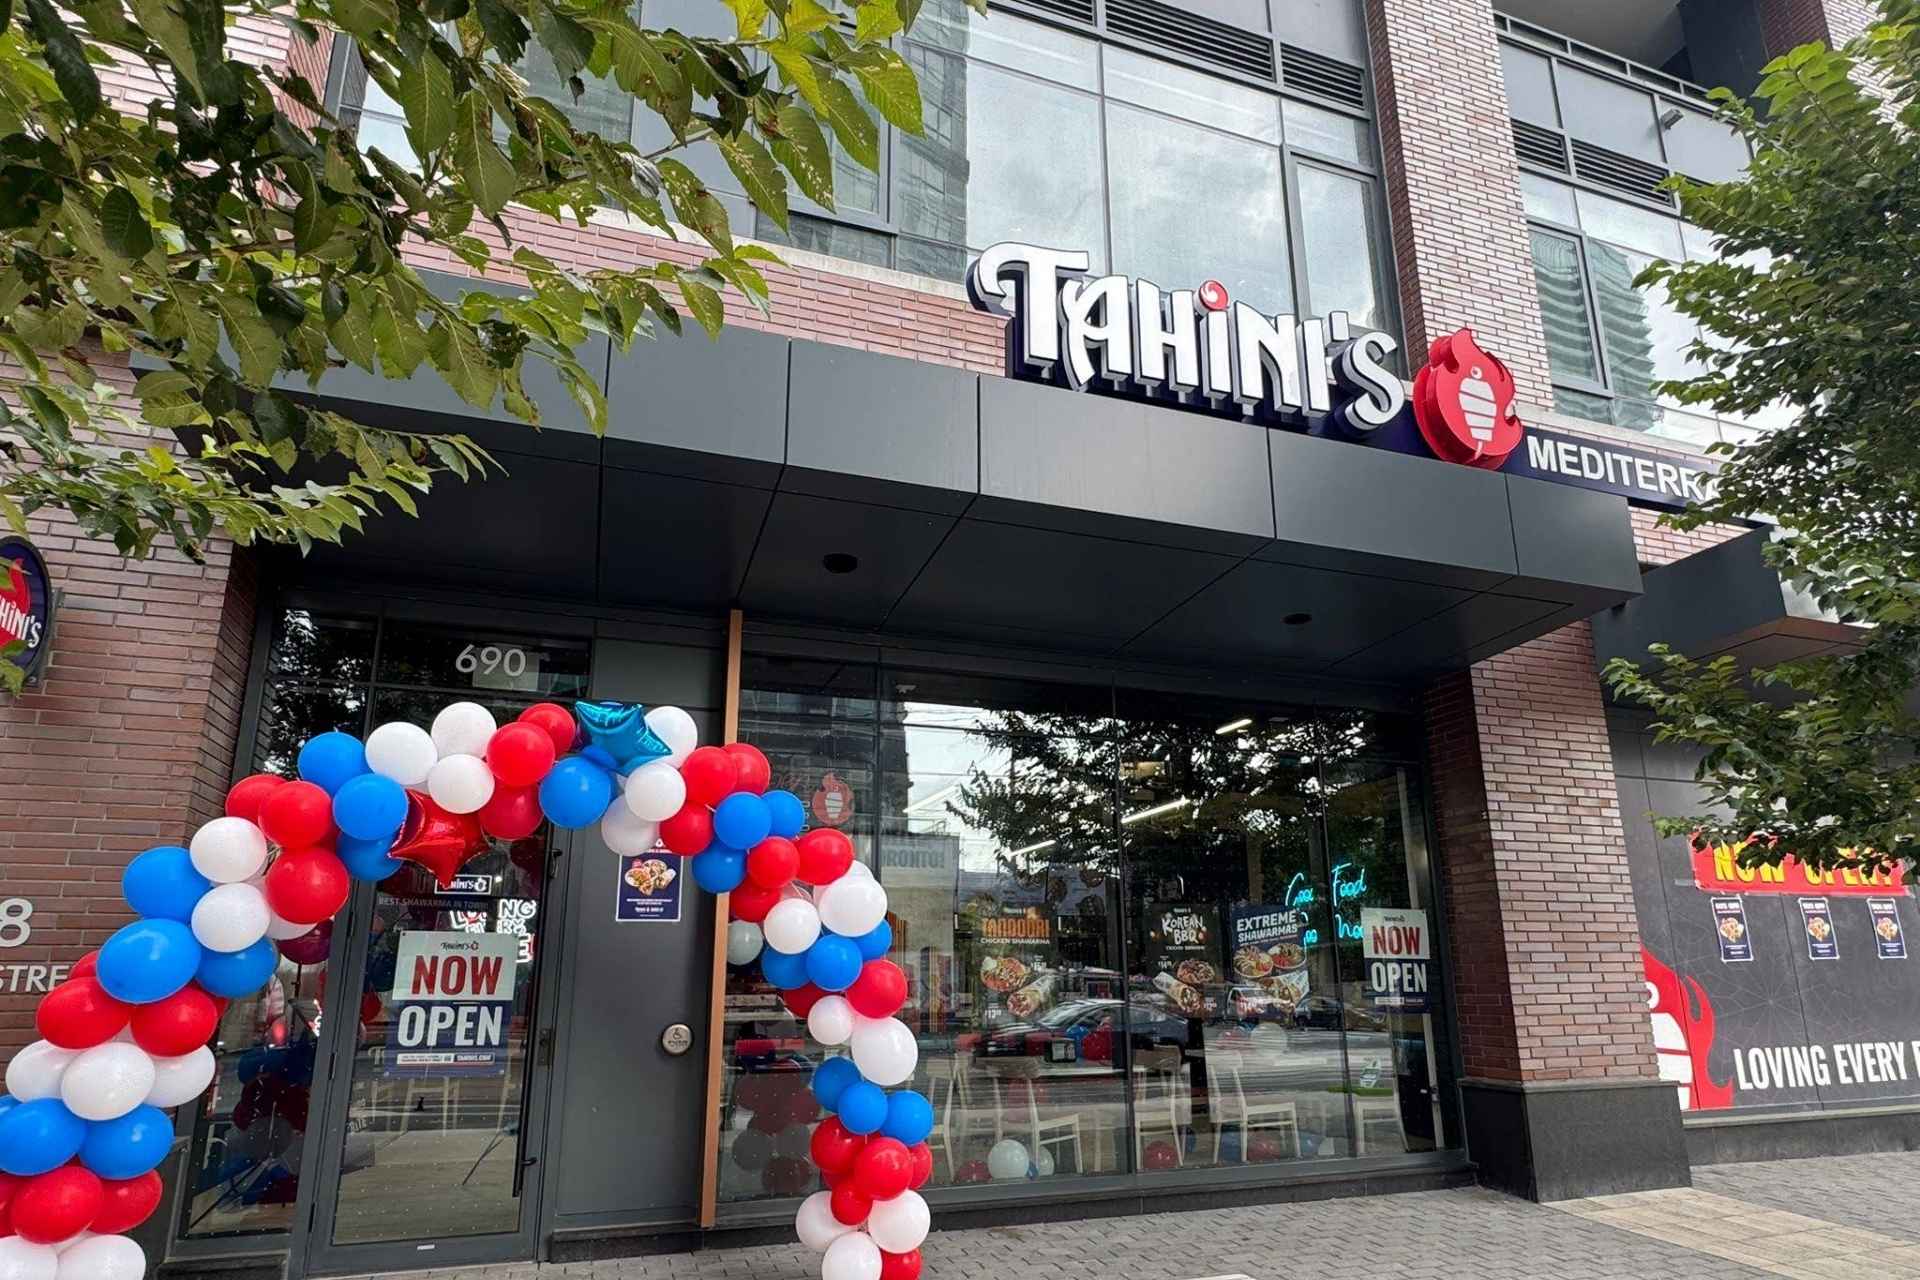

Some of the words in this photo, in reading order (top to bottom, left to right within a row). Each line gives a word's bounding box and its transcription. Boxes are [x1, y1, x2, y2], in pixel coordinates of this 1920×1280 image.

[455, 644, 526, 677] 690
[1331, 862, 1367, 907] Food
[0, 897, 34, 948] 8
[1161, 912, 1204, 937] KOREAN
[1173, 928, 1200, 945] BBQ
[1236, 909, 1297, 932] EXTREME
[1237, 923, 1298, 943] SHAWARMAS
[1372, 926, 1420, 955] NOW
[411, 955, 503, 995] NOW
[1371, 962, 1428, 993] OPEN
[397, 1005, 503, 1047] OPEN
[1733, 1046, 1832, 1090] LOVING
[1833, 1040, 1908, 1087] EVERY
